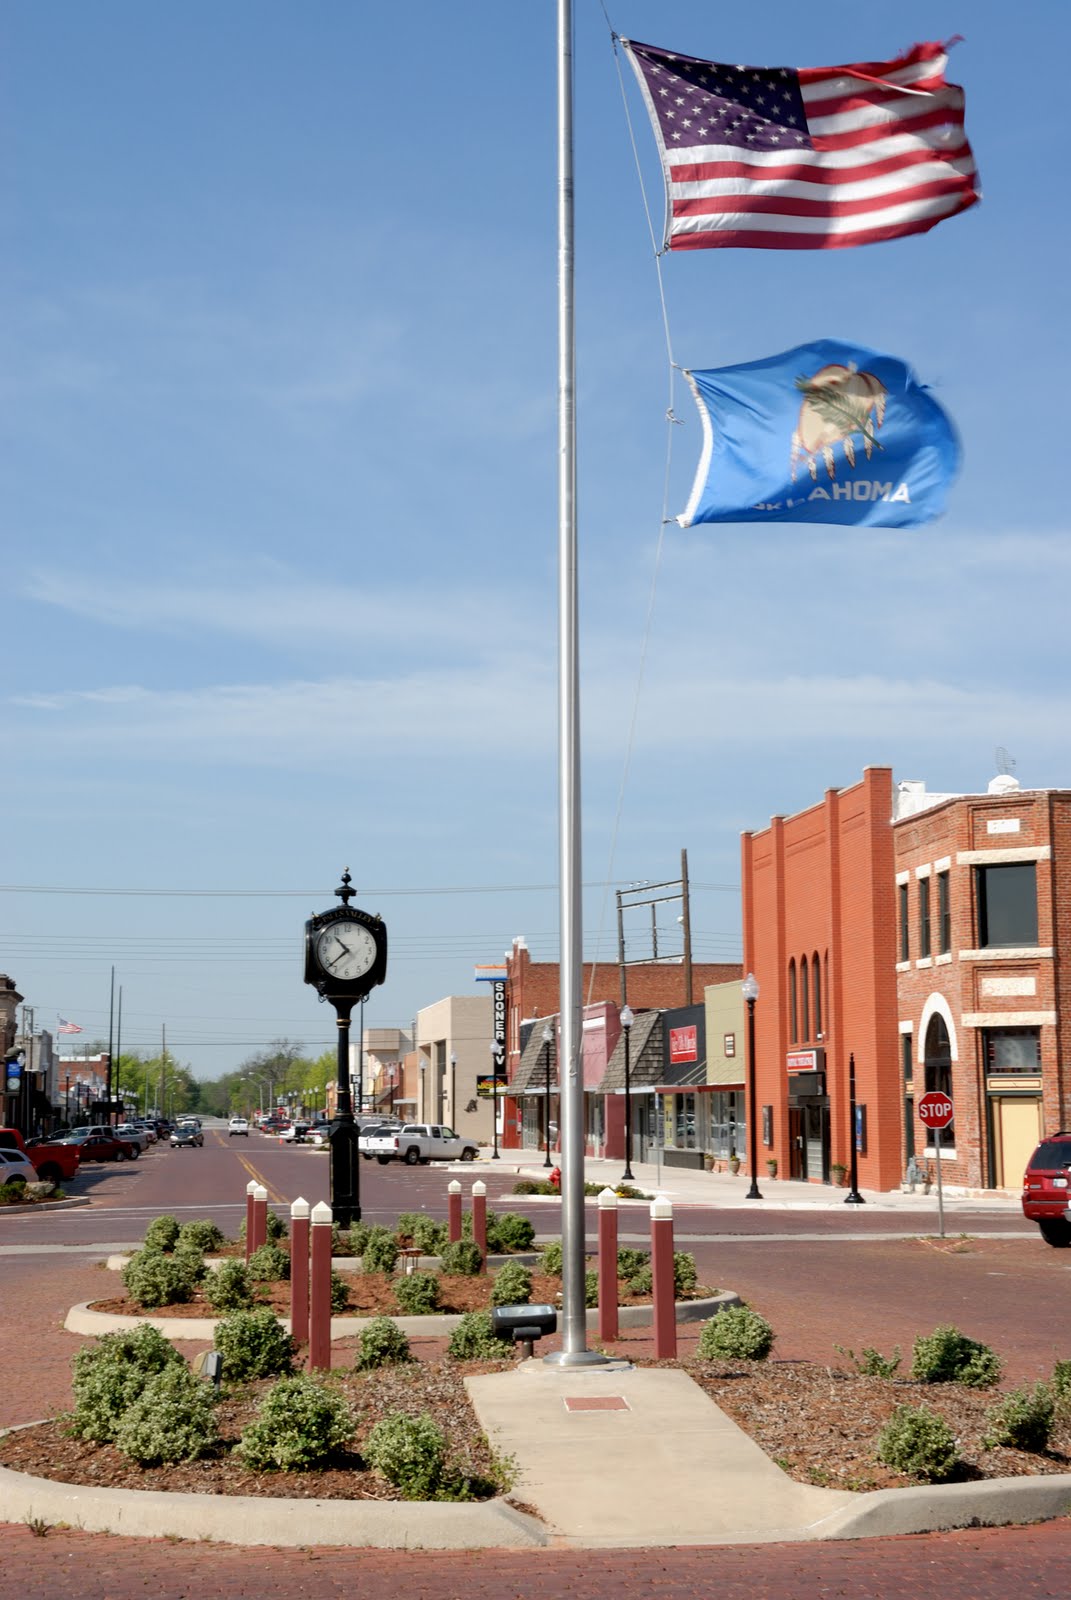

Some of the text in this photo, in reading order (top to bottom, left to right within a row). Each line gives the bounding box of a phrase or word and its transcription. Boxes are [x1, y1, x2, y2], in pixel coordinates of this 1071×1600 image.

[344, 924, 351, 933] 12
[364, 936, 370, 944] 2
[322, 946, 328, 954] 9
[324, 956, 330, 965] 8
[332, 966, 338, 975] 7
[344, 968, 350, 977] 6
[495, 982, 505, 1040] SOONER
[496, 1046, 506, 1065] TV
[920, 1102, 952, 1118] STOP
